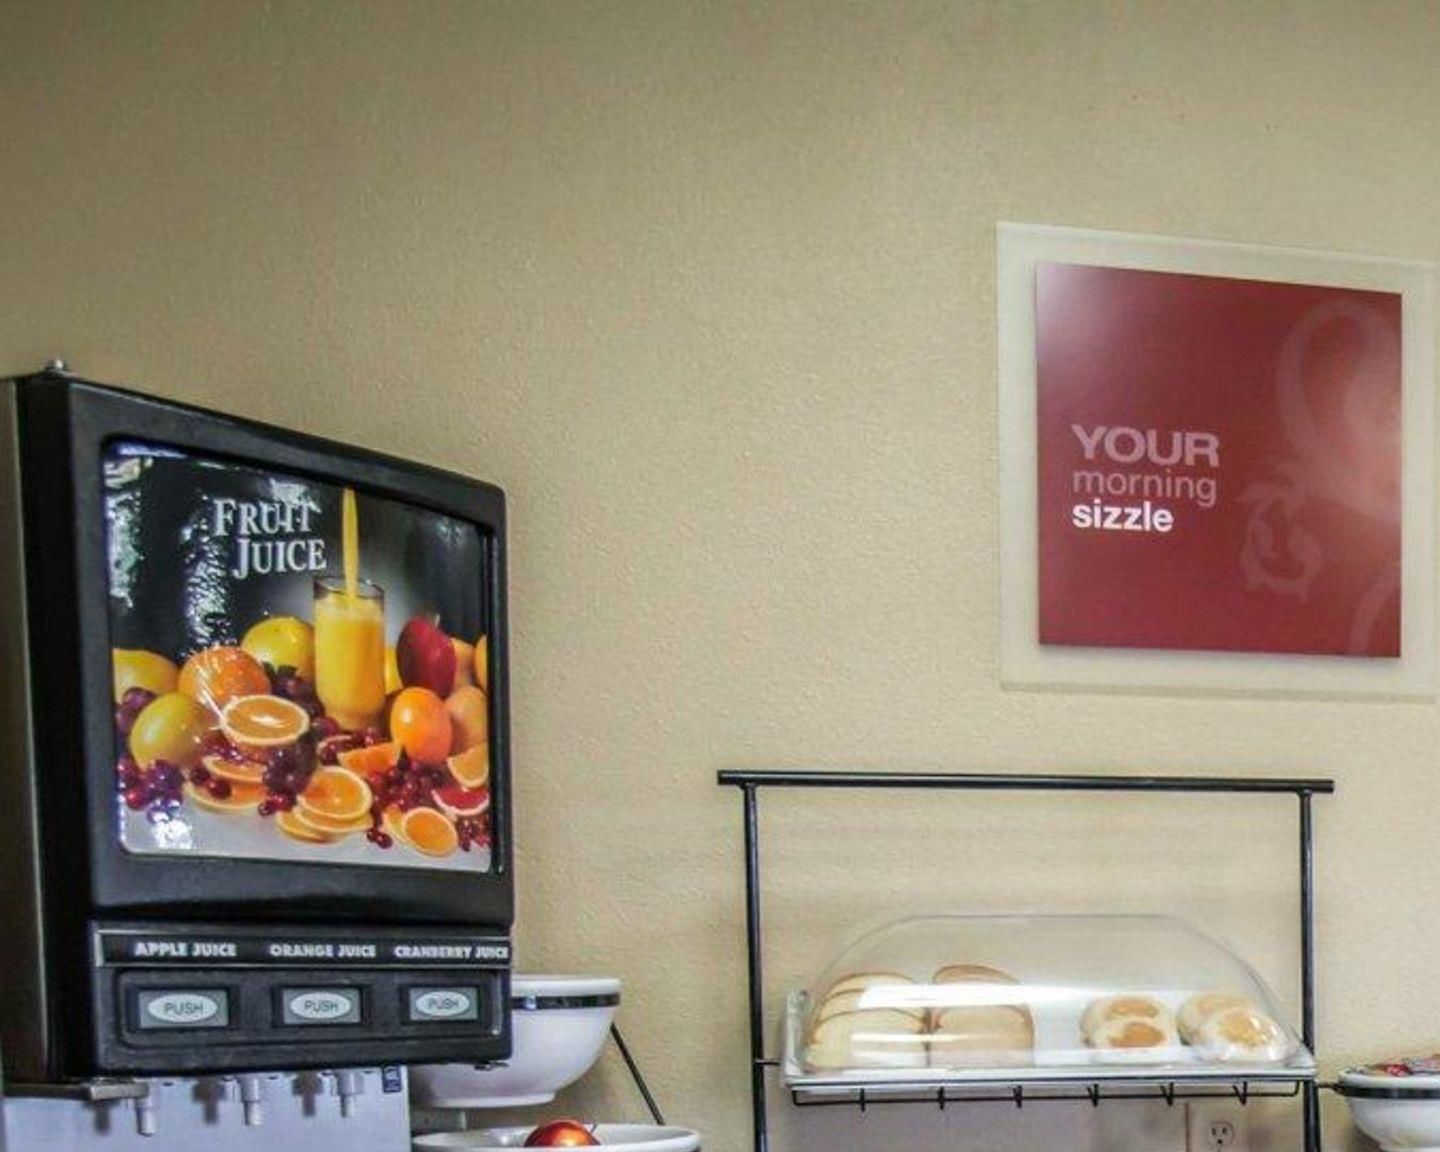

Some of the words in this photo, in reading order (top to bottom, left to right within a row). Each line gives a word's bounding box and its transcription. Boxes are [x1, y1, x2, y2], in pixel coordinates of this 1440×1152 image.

[1070, 424, 1220, 467] YOUR
[1072, 469, 1217, 507] morning
[213, 498, 316, 536] FRUIT
[1072, 498, 1174, 532] sizzle
[232, 538, 327, 580] JUICE
[135, 942, 188, 957] APPLE
[191, 943, 237, 957] JUICE
[270, 944, 334, 957] ORANGE
[337, 944, 377, 958] JUICE
[394, 945, 472, 959] CRANBERRY
[475, 946, 509, 959] JUICE
[164, 1002, 204, 1016] PUSH
[304, 1000, 339, 1012] PUSH
[428, 998, 460, 1010] PUSH
